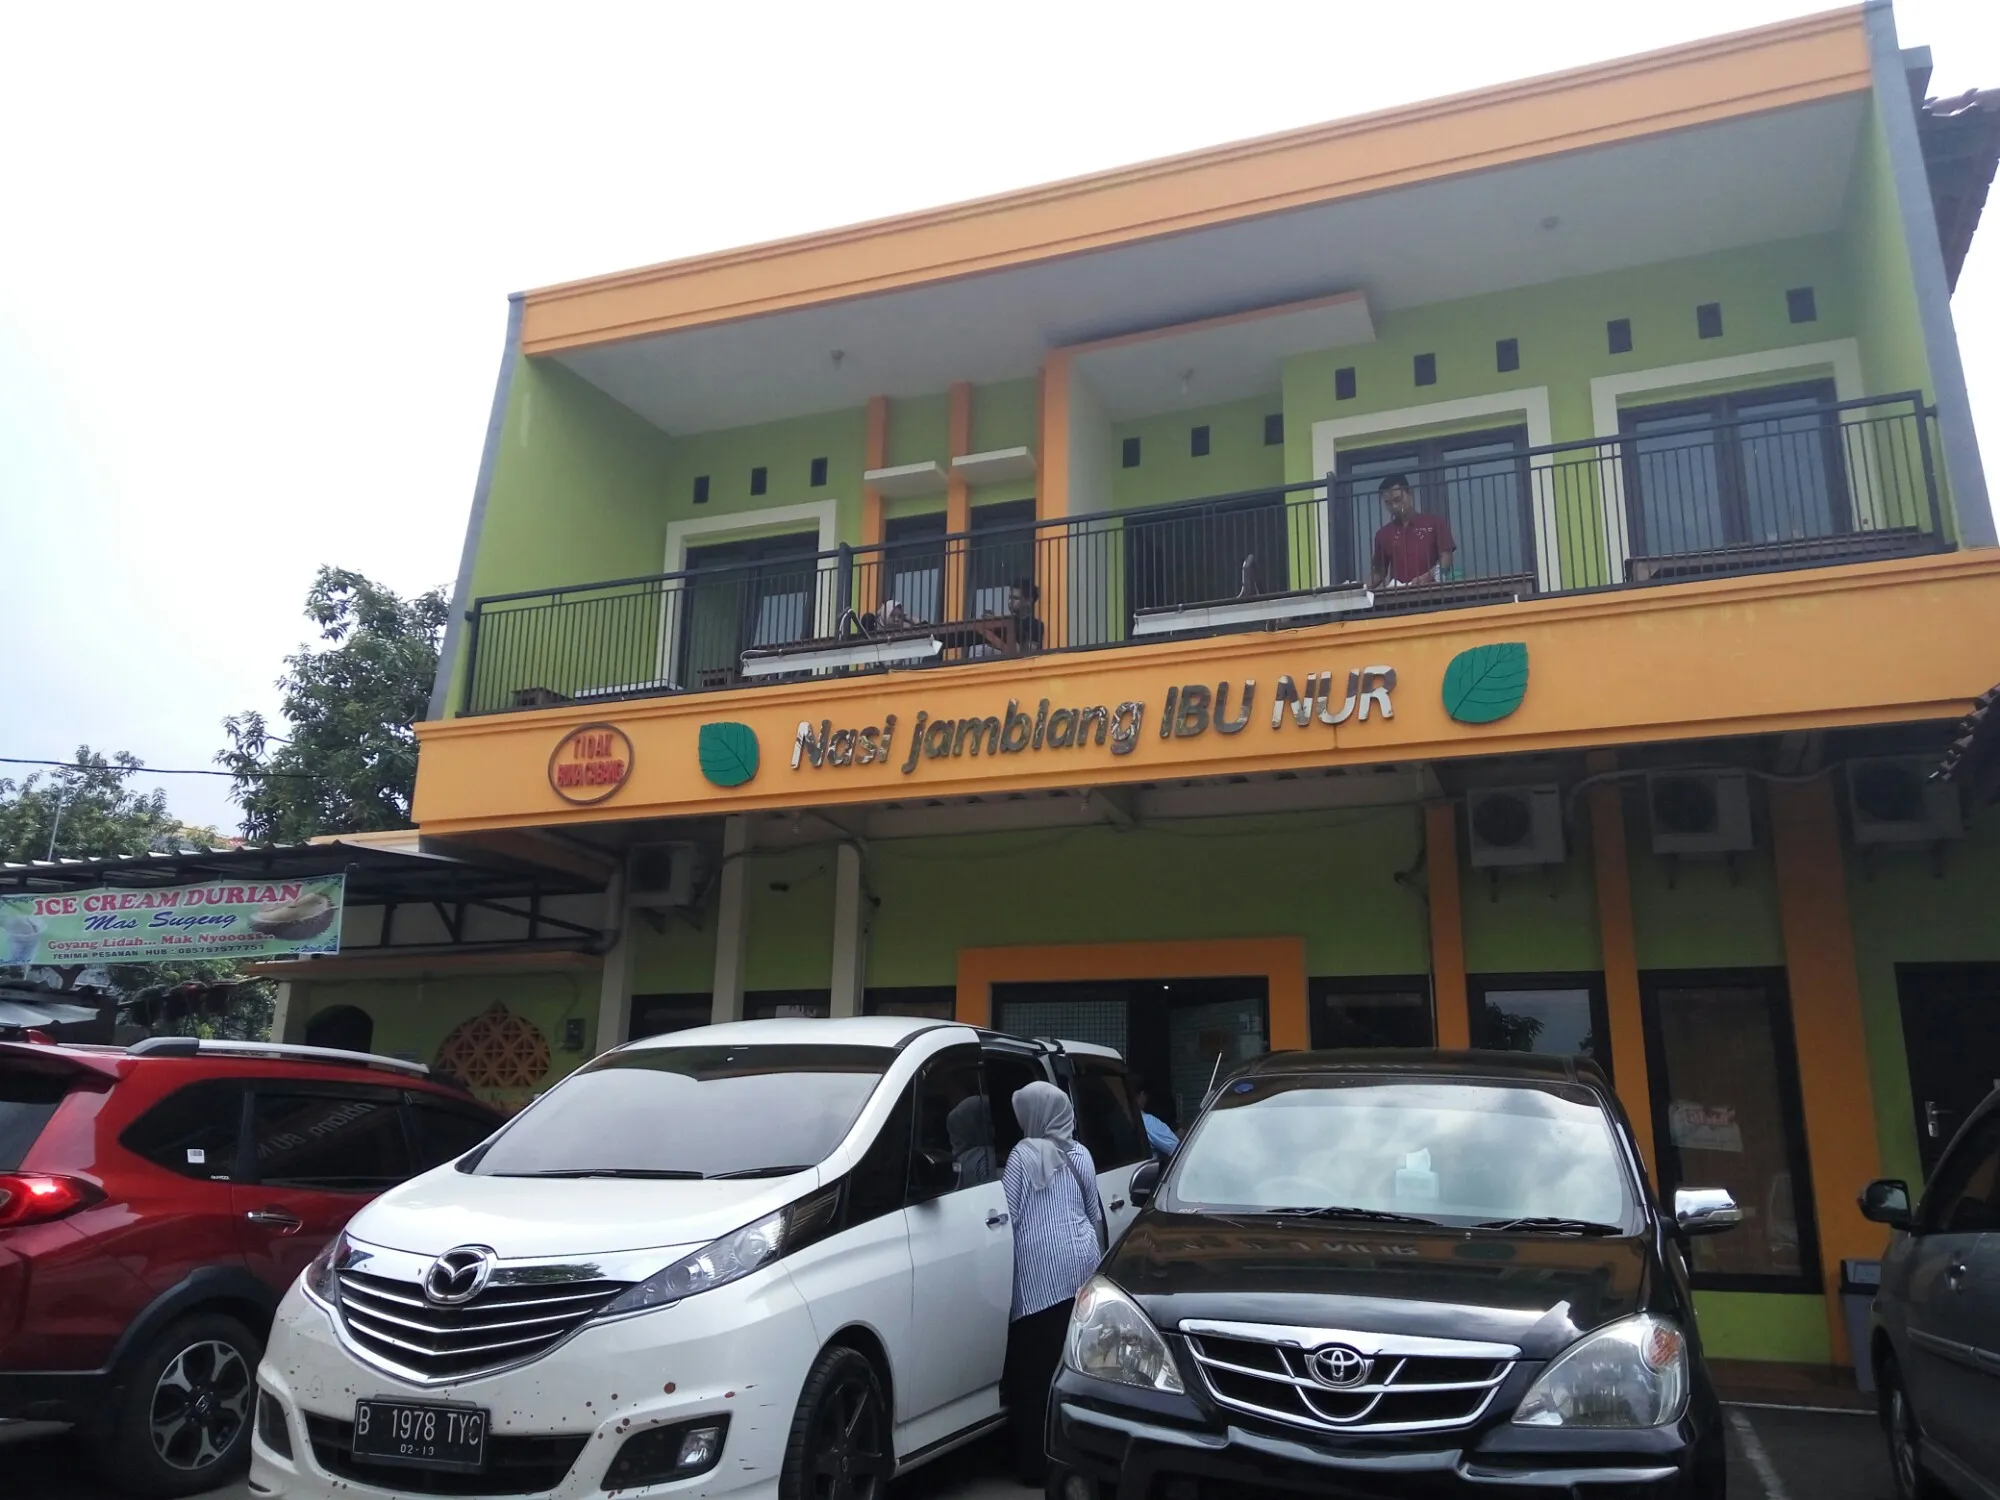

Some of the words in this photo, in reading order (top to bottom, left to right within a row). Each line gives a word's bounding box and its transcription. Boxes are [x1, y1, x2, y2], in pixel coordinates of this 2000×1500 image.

[790, 713, 897, 769] Nasi
[900, 695, 1147, 774] jamblang
[1158, 679, 1256, 739] IBU
[1270, 664, 1398, 729] NUR
[573, 733, 612, 760] TIDAK
[34, 897, 78, 916] ICE
[82, 891, 180, 912] CREAM
[184, 884, 303, 906] DURIAN
[84, 914, 139, 931] Mas
[148, 911, 239, 931] Sugeng
[48, 939, 99, 951] Goyang
[161, 935, 192, 945] Mak
[92, 950, 139, 958] PESANAN
[146, 948, 168, 956] HUB
[358, 1406, 371, 1435] B
[392, 1409, 436, 1441] 1978
[400, 1443, 435, 1456] 02-13
